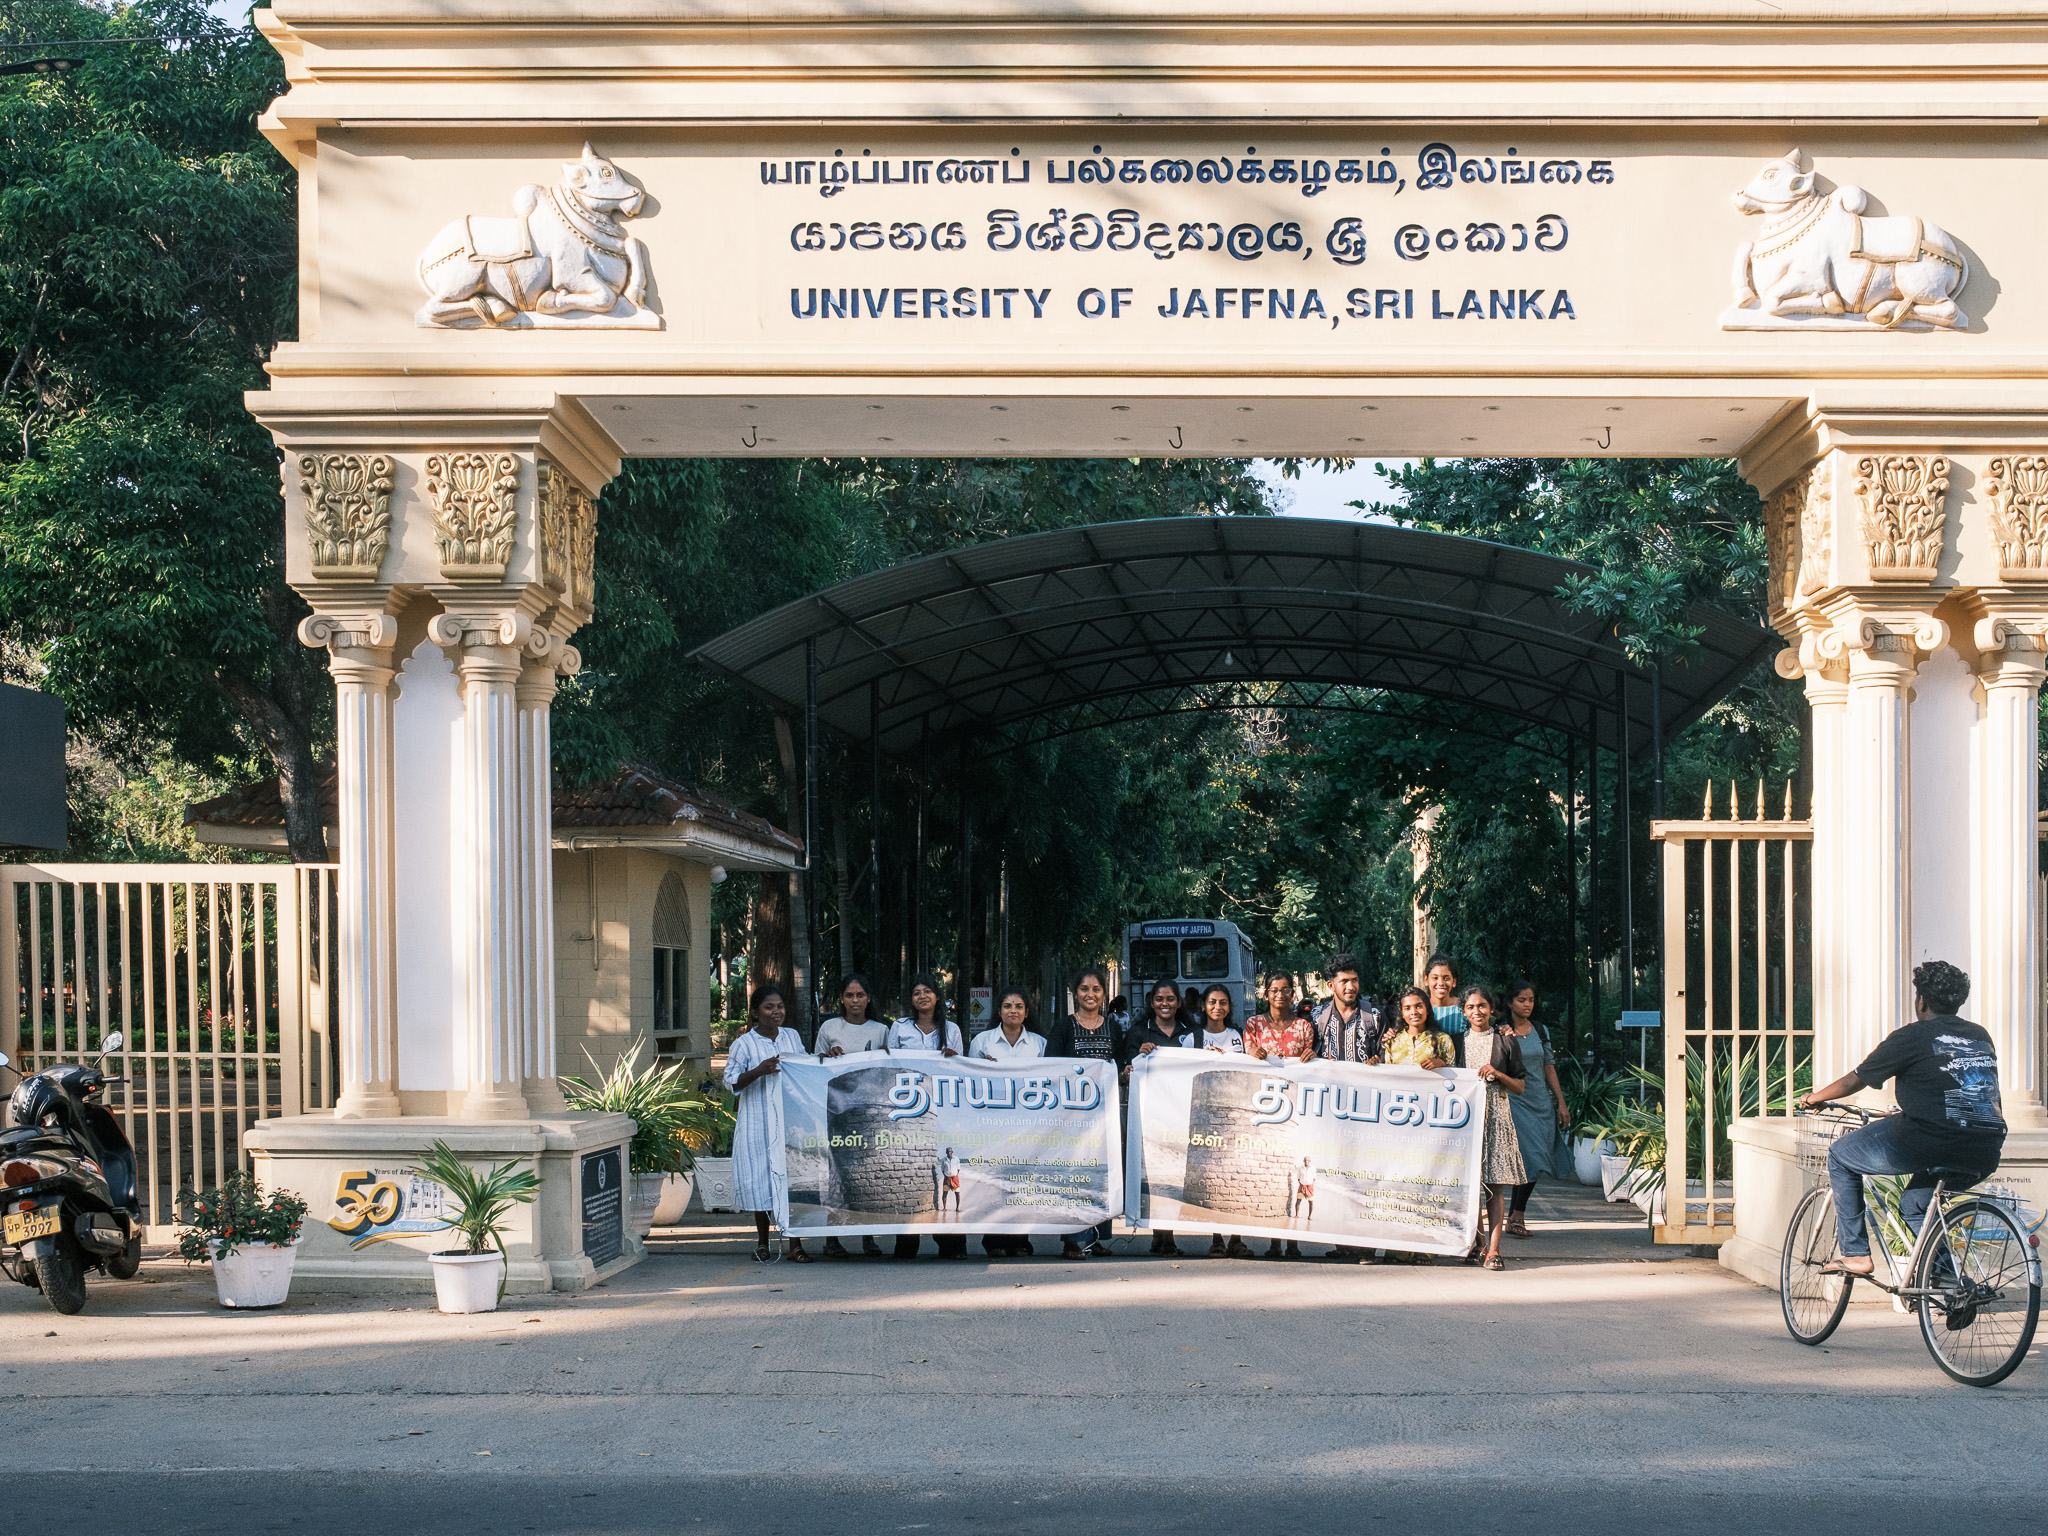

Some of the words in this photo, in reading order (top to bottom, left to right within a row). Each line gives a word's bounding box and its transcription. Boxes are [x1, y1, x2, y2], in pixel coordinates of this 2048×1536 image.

[760, 148, 1030, 198] யாழ்ப்பாணப்
[790, 221, 966, 252] යාපනය
[1394, 214, 1569, 261] ලංකාව
[790, 287, 1053, 319] UNIVERSITY
[1077, 287, 1134, 319] OF
[1431, 289, 1577, 320] LANKA
[1144, 926, 1180, 935] UNIVERSITY
[1181, 926, 1189, 934] OF
[1190, 925, 1213, 934] JAFFNA
[888, 1065, 1100, 1121] தாயகம்
[1249, 1080, 1470, 1129] தாயகம்
[1040, 1174, 1067, 1184] 23-27,
[1069, 1175, 1091, 1183] 2026
[1427, 1194, 1451, 1203] 2026
[327, 1171, 403, 1236] 50
